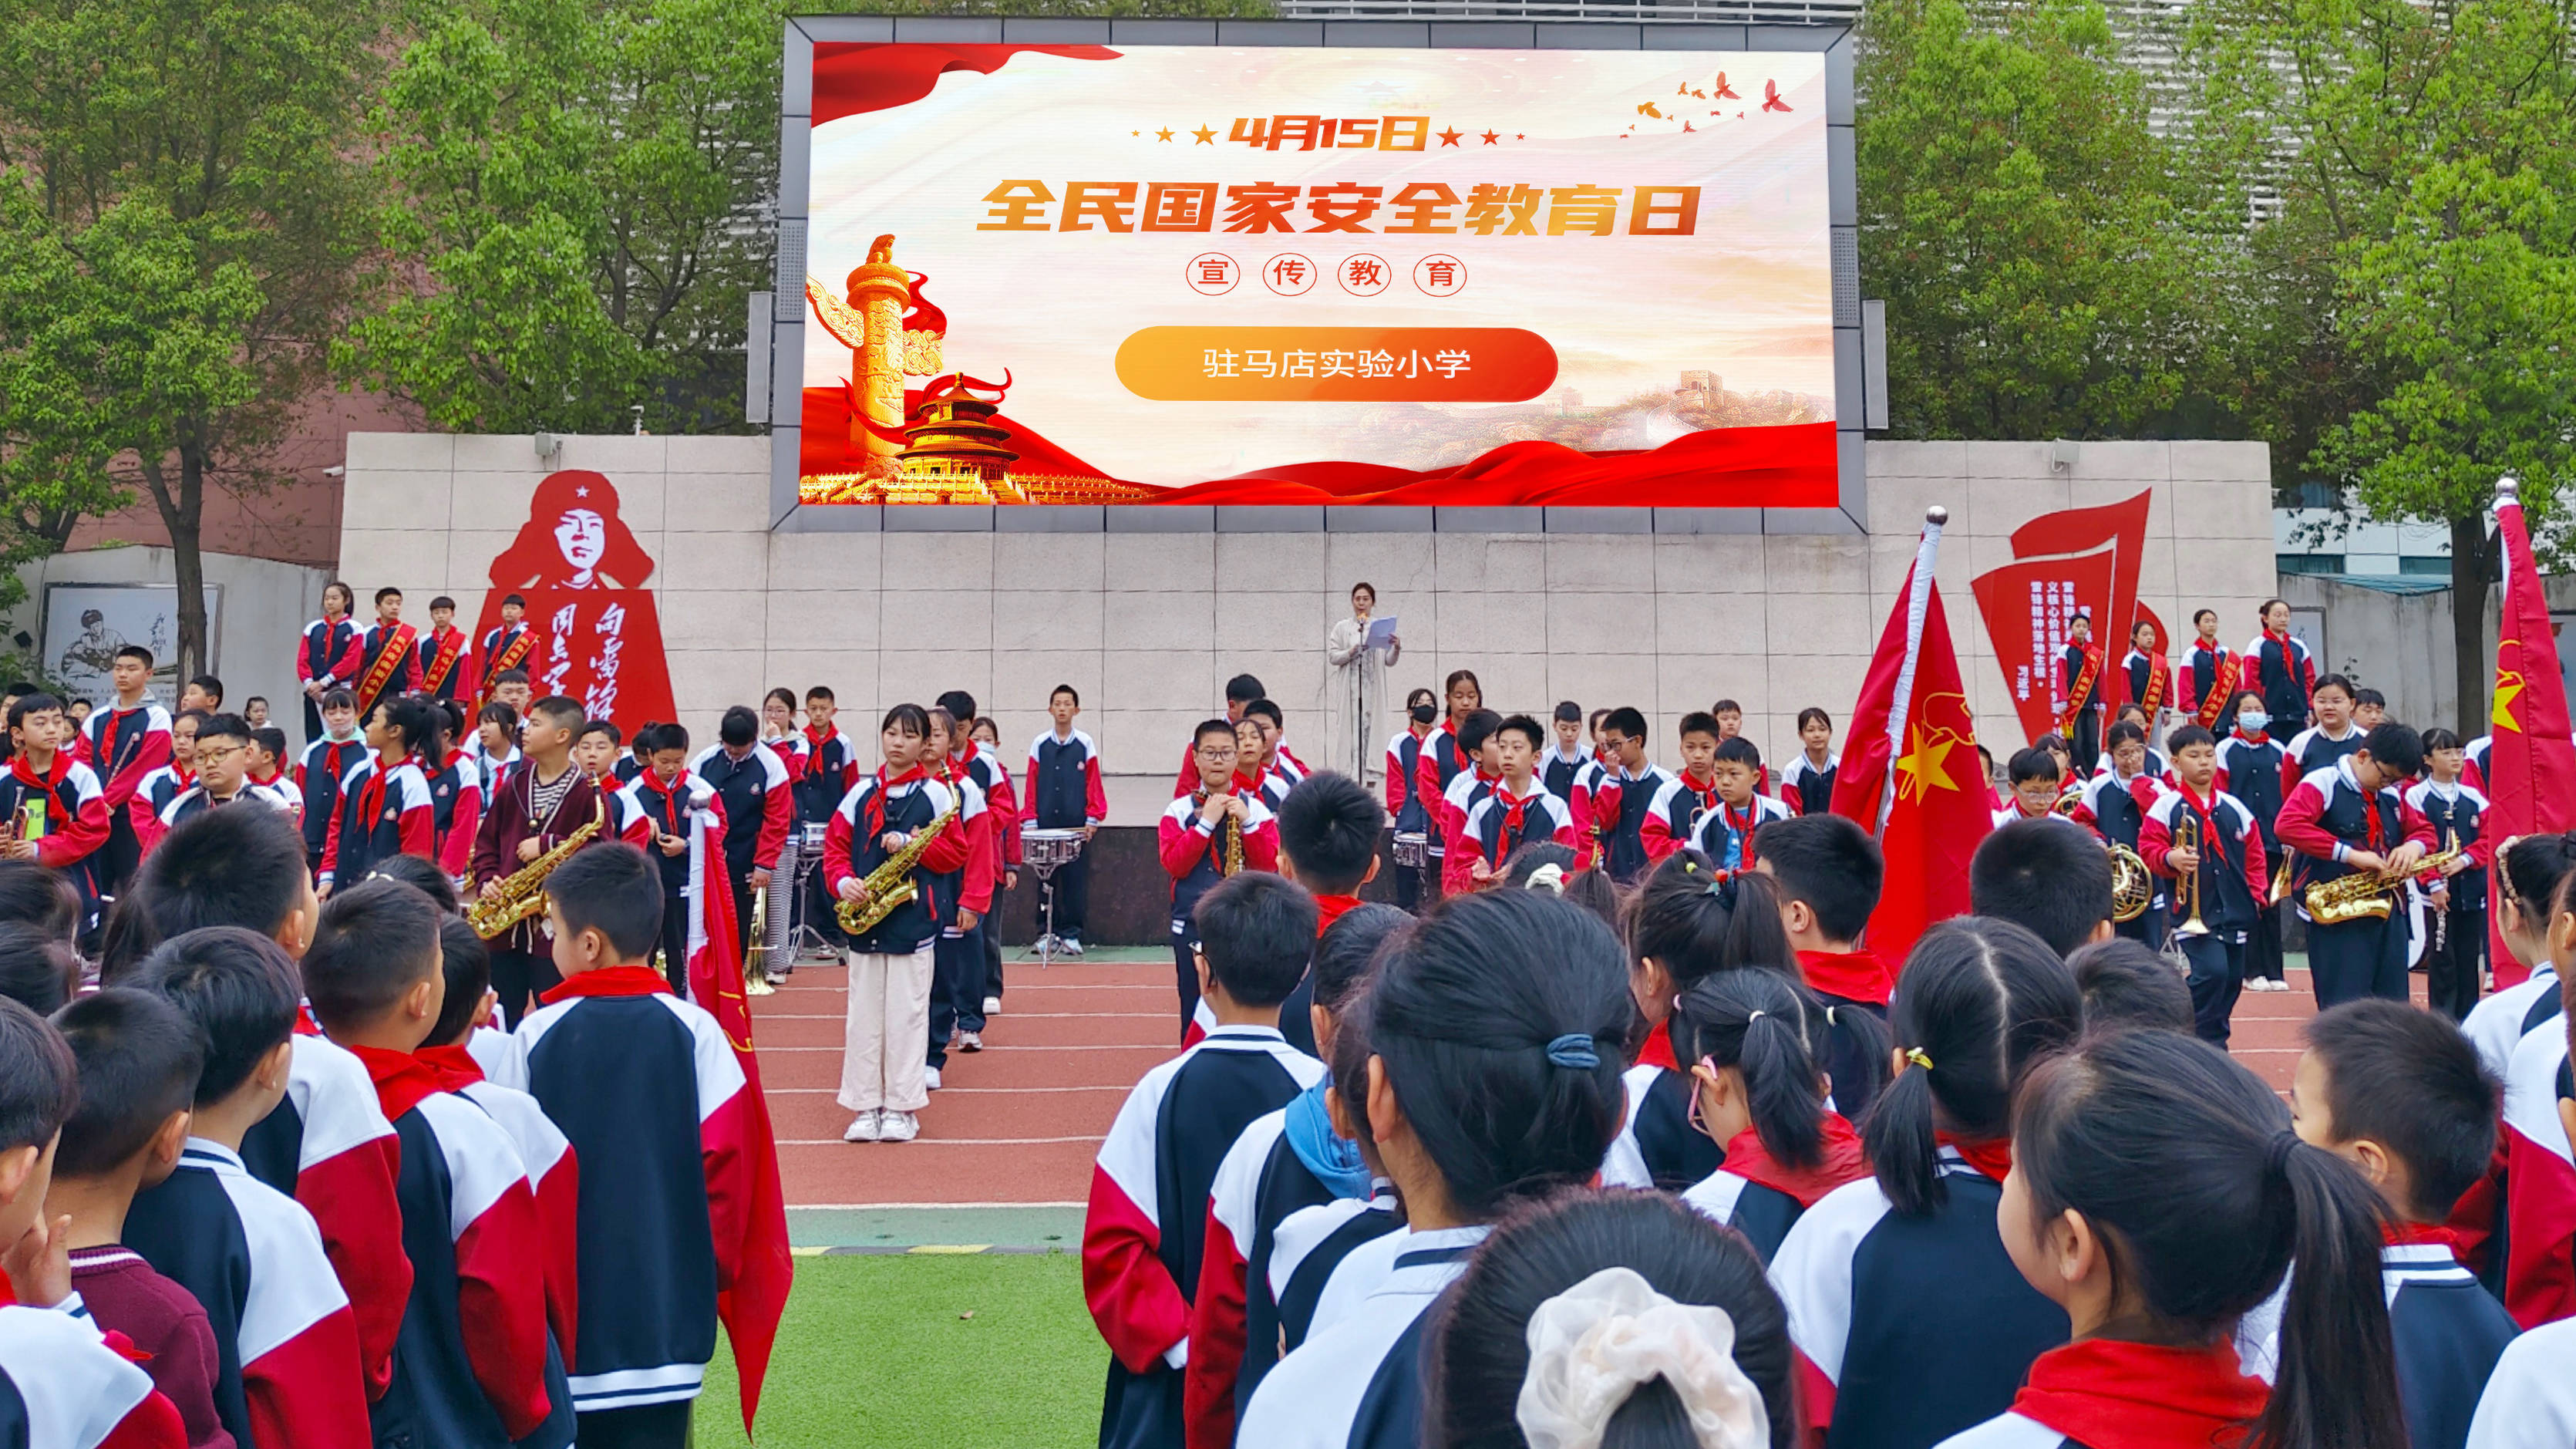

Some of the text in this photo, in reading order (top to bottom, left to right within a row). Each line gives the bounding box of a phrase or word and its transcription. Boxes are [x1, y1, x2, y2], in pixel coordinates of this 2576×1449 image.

[1228, 115, 1430, 151] 4月15日
[975, 178, 1702, 236] 全民国家安全教育日
[1197, 258, 1457, 287] 宣传教育
[1202, 348, 1472, 379] 驻马店实验小学
